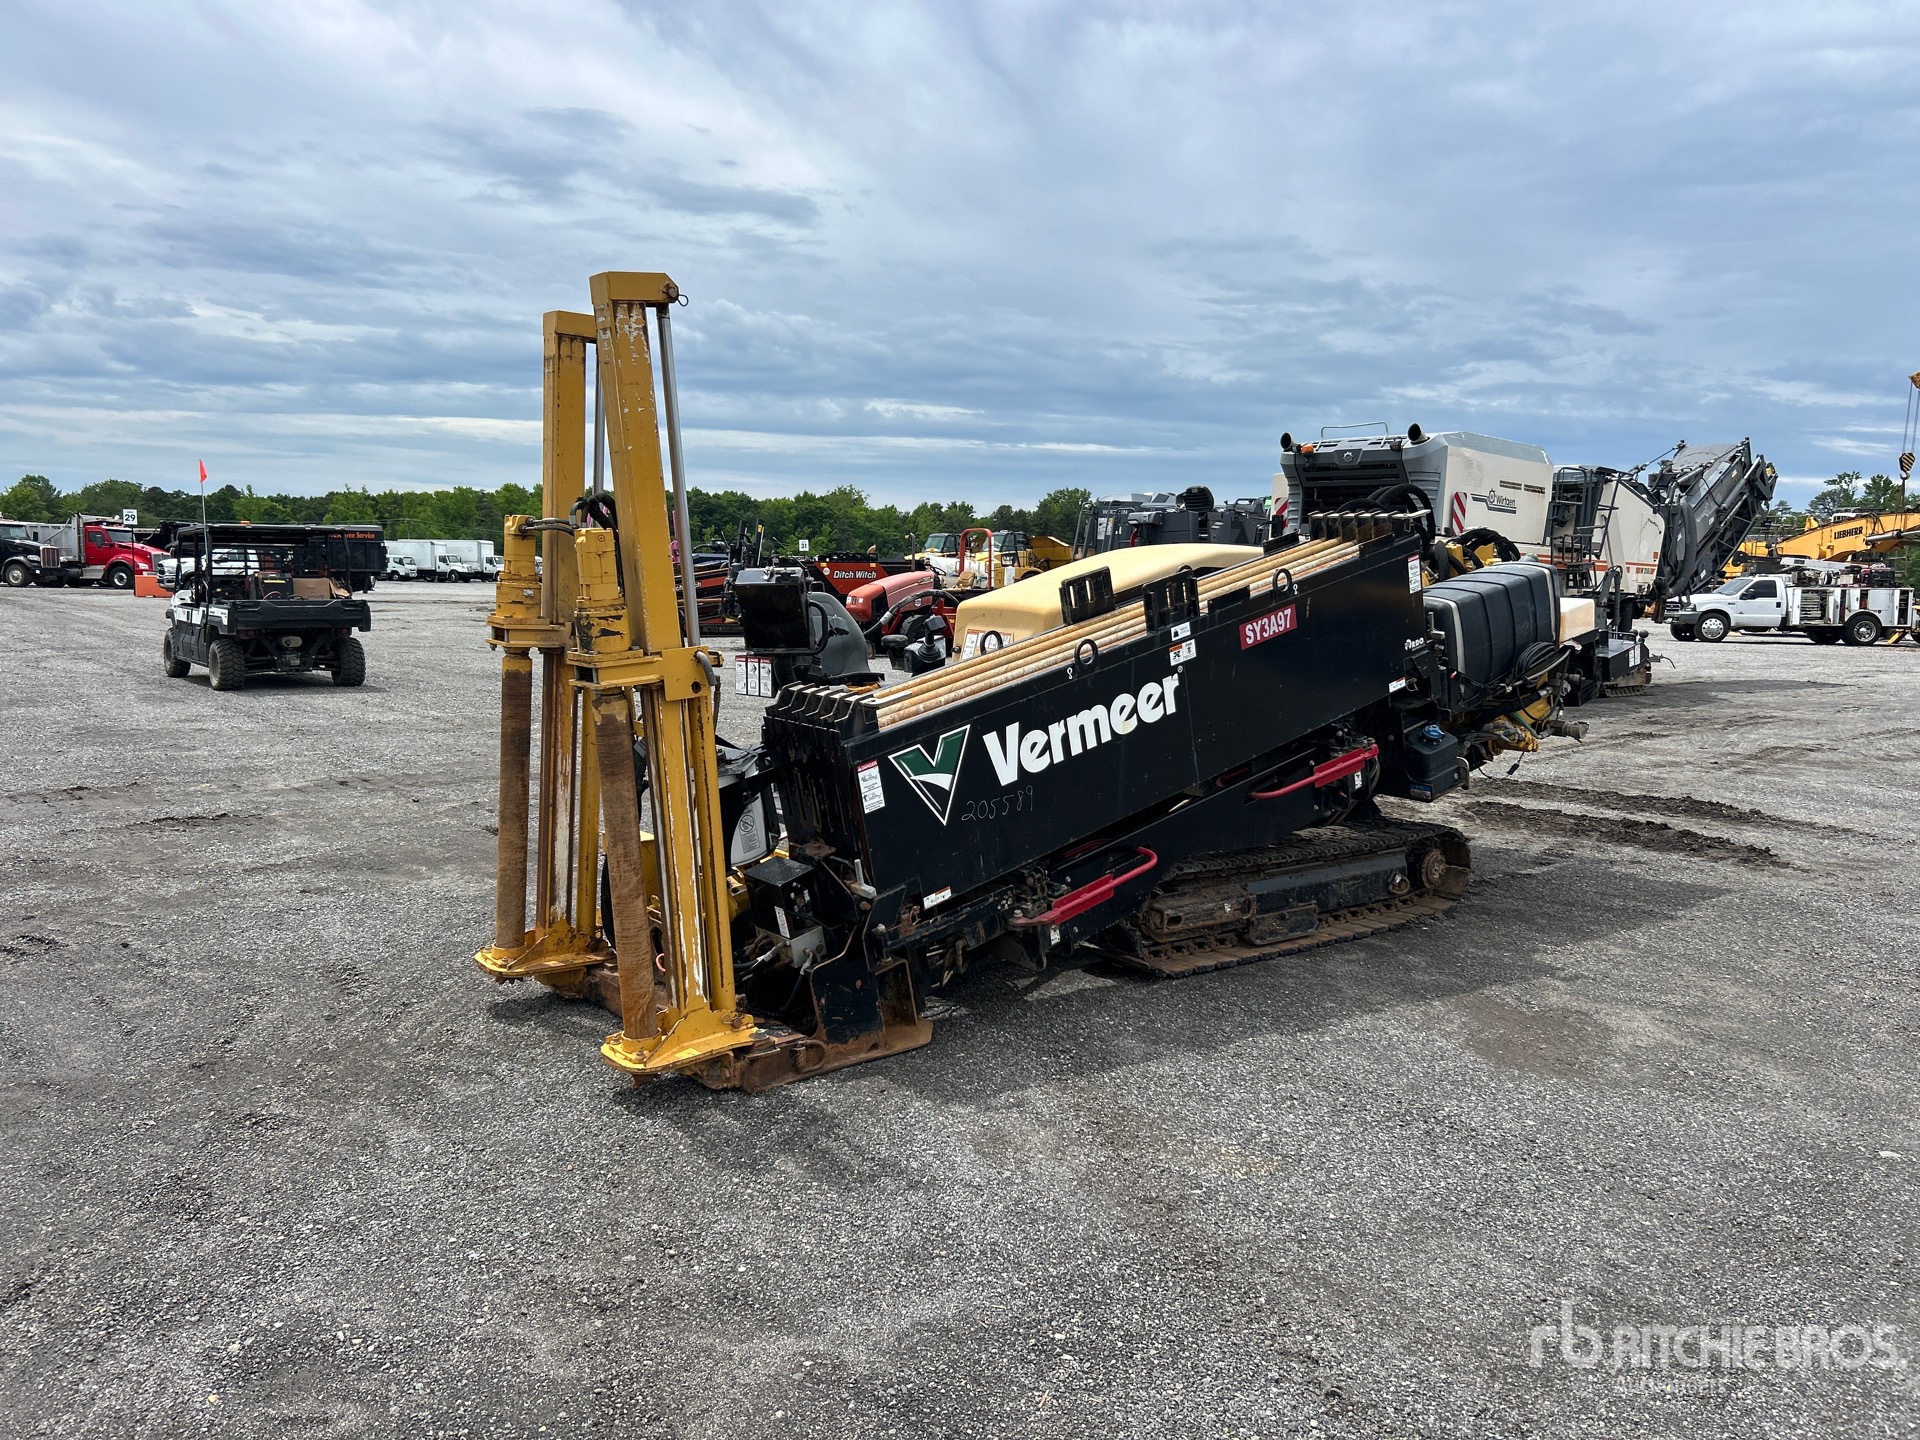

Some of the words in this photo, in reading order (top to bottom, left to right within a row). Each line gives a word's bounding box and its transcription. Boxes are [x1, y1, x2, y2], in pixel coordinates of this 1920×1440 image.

[1496, 495, 1516, 508] Wirtgen
[1834, 526, 1863, 539] LIEBHERR
[833, 570, 854, 579] Ditch
[855, 570, 876, 579] Witch
[1245, 608, 1291, 644] SY3A97
[982, 673, 1180, 787] Vermeer
[961, 785, 1033, 821] 205589
